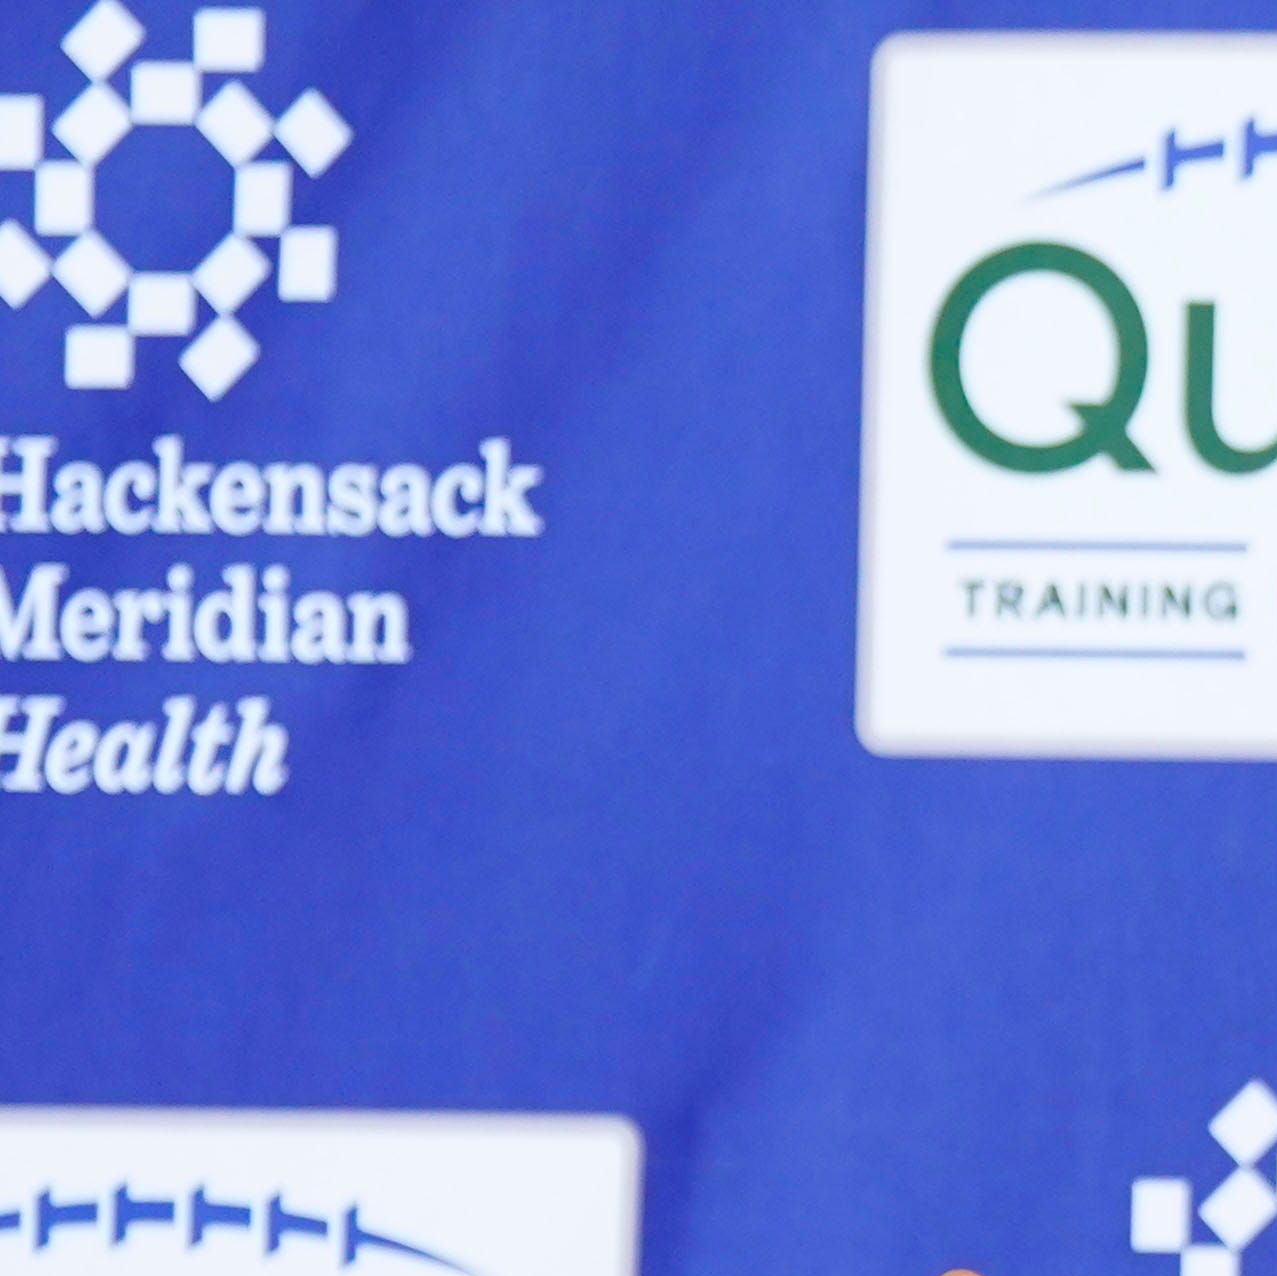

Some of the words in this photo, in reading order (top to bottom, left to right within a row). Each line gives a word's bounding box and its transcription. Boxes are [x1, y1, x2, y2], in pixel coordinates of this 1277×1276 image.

[0, 434, 545, 538] Hackensack
[0, 563, 411, 664] Meridian
[962, 580, 1240, 622] TRAINING
[0, 695, 288, 796] Health
